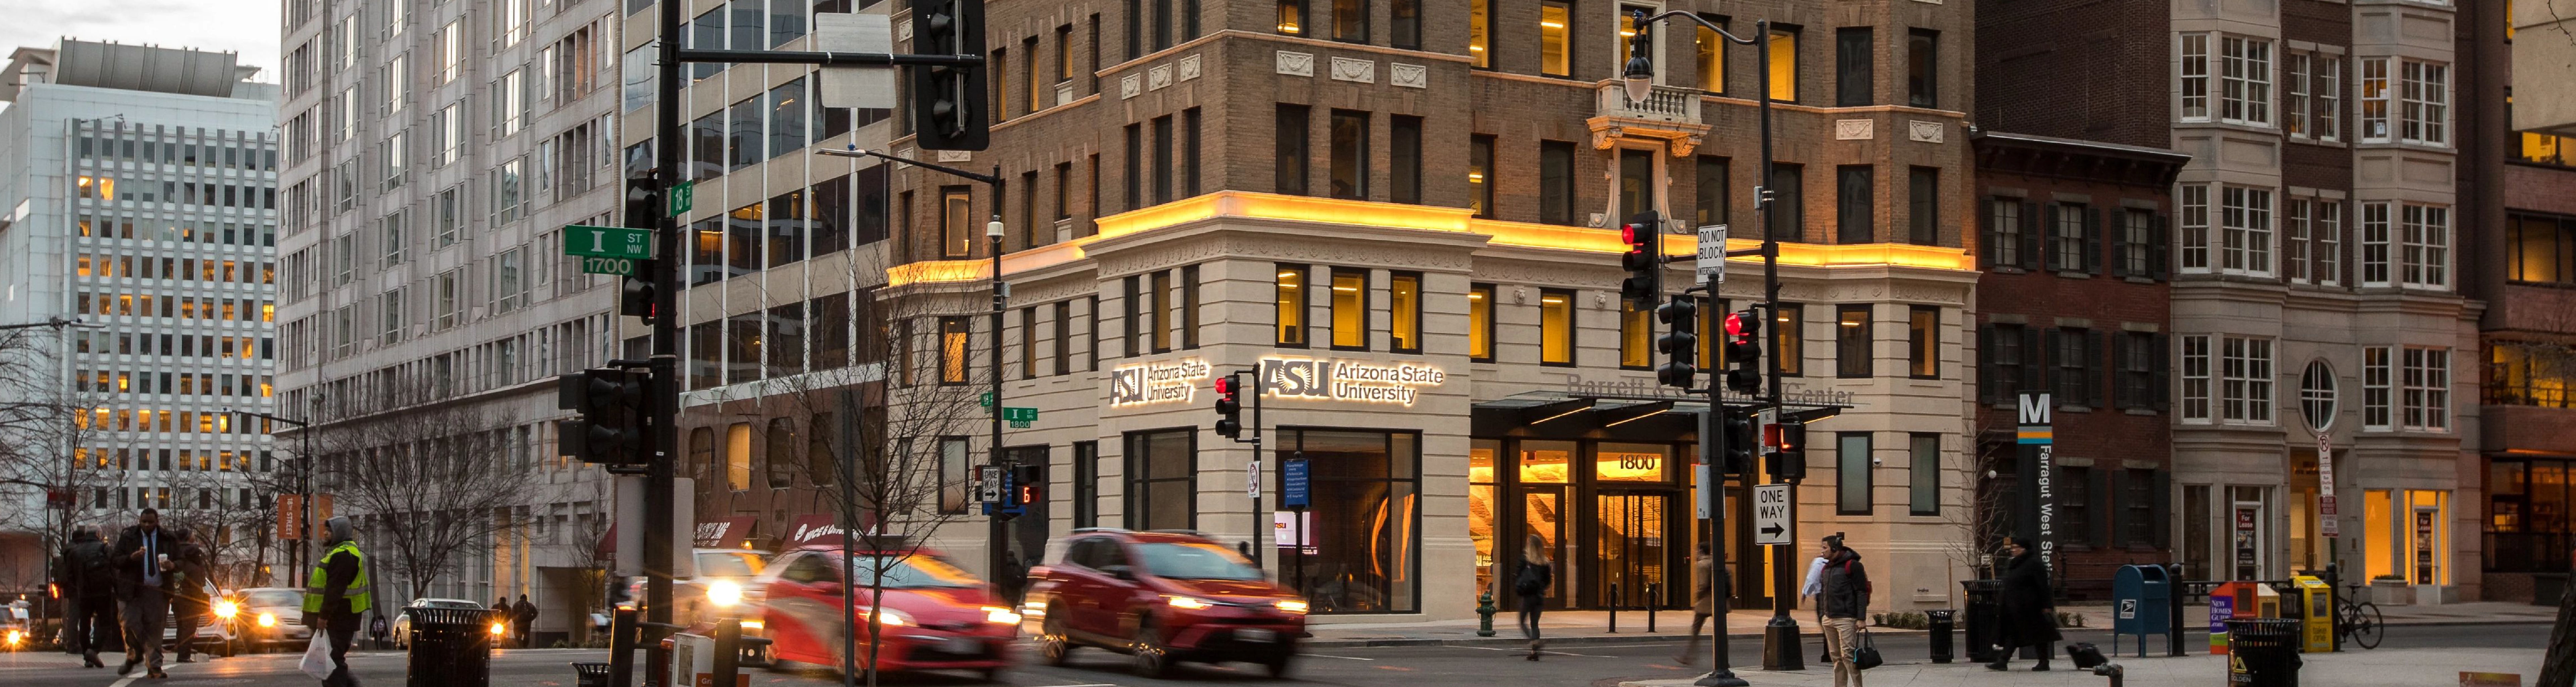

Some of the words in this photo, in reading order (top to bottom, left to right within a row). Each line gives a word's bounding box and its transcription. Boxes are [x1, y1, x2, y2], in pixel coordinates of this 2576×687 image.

[686, 185, 691, 196] ST
[675, 189, 683, 211] 18
[591, 231, 605, 252] I
[628, 234, 642, 243] ST
[1700, 231, 1709, 243] DO
[1711, 229, 1724, 242] NOT
[627, 245, 642, 254] NW
[1699, 246, 1724, 259] BLOCK
[586, 258, 631, 274] 1700
[1109, 368, 1146, 404] ASU
[1147, 365, 1180, 382] Arizona
[1182, 361, 1206, 378] State
[1260, 360, 1330, 397] ASU
[1336, 363, 1399, 381] Arizona
[1402, 366, 1444, 383] State
[1147, 383, 1191, 401] University
[1336, 383, 1416, 404] University
[1567, 374, 1645, 395] Barrett
[1653, 379, 1667, 399] &
[1785, 382, 1854, 403] Center
[1012, 409, 1019, 419] I
[2019, 394, 2050, 424] M
[1618, 454, 1655, 470] 1800
[985, 470, 997, 478] ONE
[2038, 445, 2051, 498] Farragut
[984, 480, 998, 488] WAY
[1023, 486, 1030, 503] 6
[1761, 490, 1784, 503] ONE
[1760, 506, 1785, 519] WAY
[2041, 504, 2052, 535] West
[2042, 541, 2053, 576] Stati
